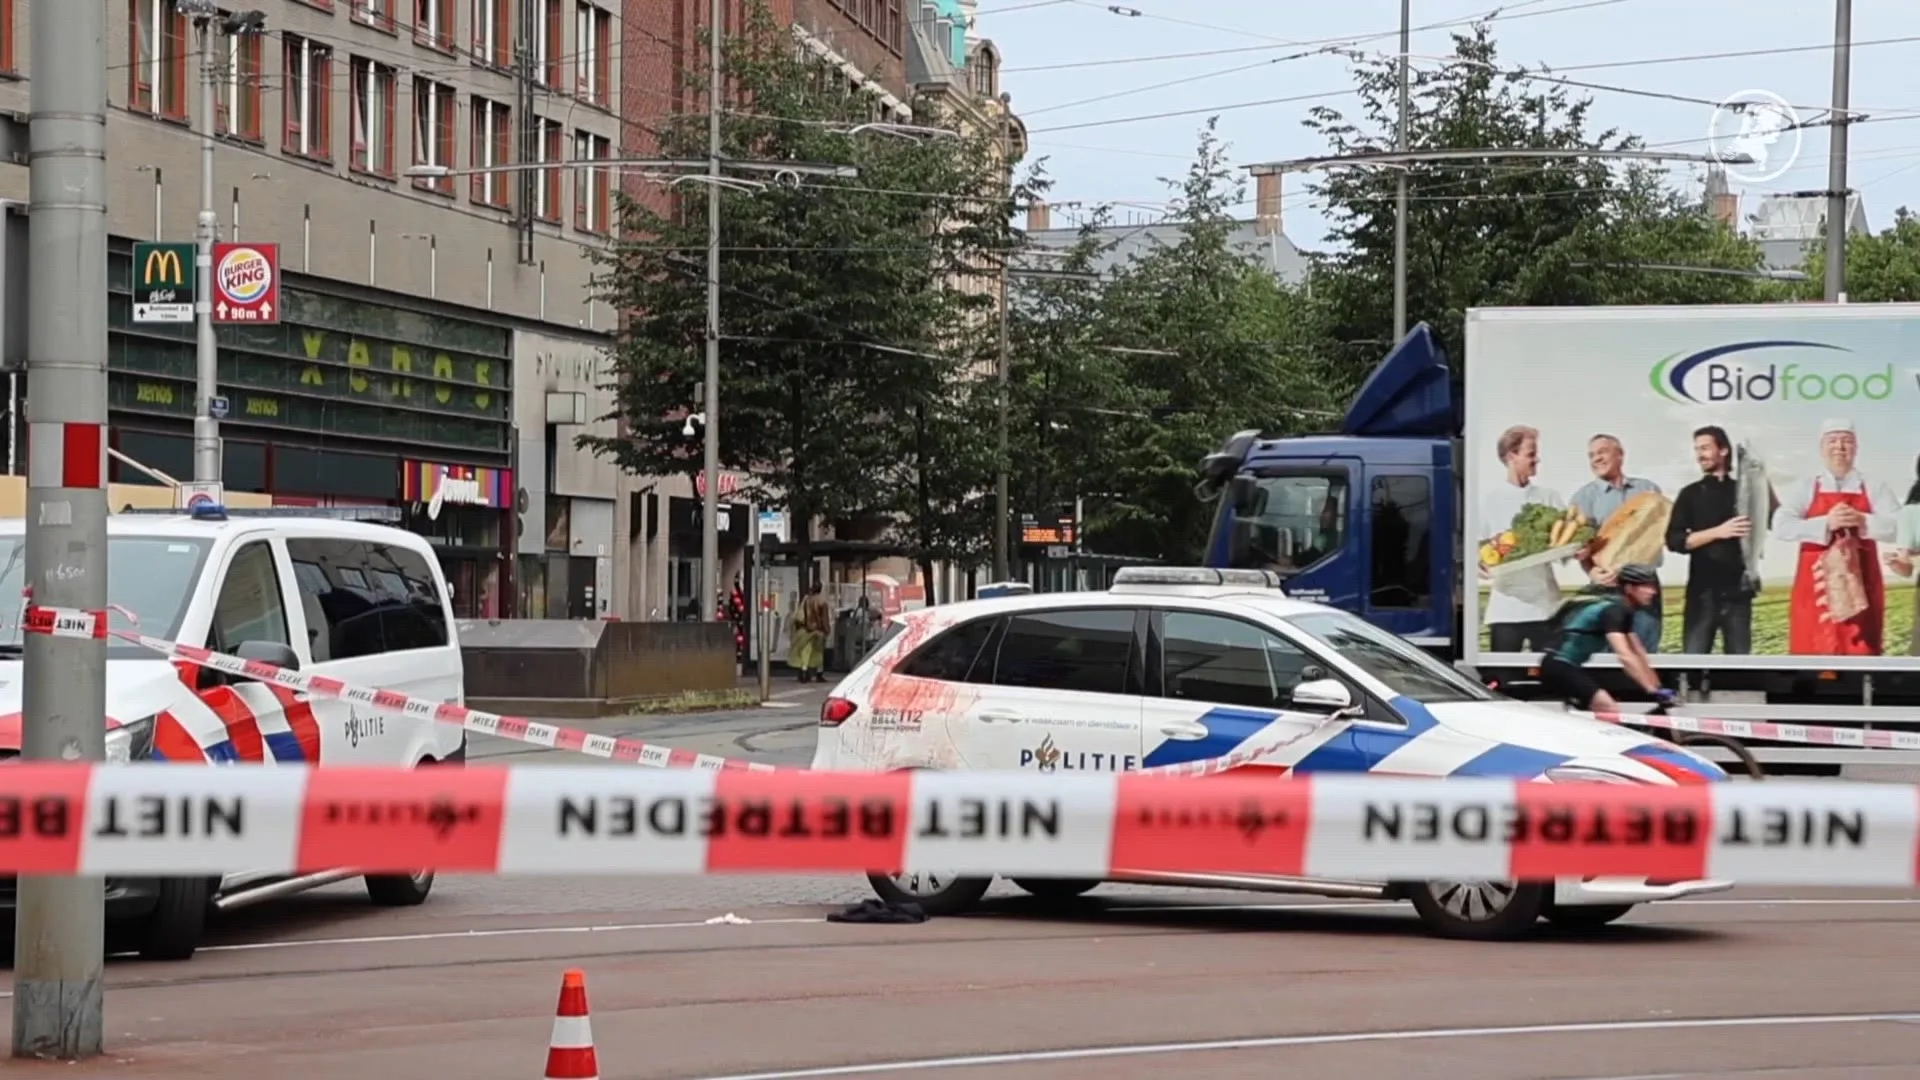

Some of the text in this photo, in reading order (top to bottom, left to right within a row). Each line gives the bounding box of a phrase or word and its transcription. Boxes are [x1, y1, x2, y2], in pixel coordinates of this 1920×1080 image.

[224, 258, 263, 277] BURGER
[225, 267, 265, 290] KING
[231, 307, 257, 320] 90m
[137, 382, 173, 405] xenos
[1708, 363, 1894, 401] Bidfood
[57, 619, 86, 631] NIET
[345, 708, 384, 745] POLITIE
[900, 708, 922, 723] 112
[1020, 739, 1136, 774] POLITIE
[93, 797, 244, 838] NIET
[557, 797, 895, 840] BETREDEN
[919, 797, 1061, 840] NIET
[1363, 803, 1698, 846] BETREDEN
[1720, 807, 1866, 846] NIET
